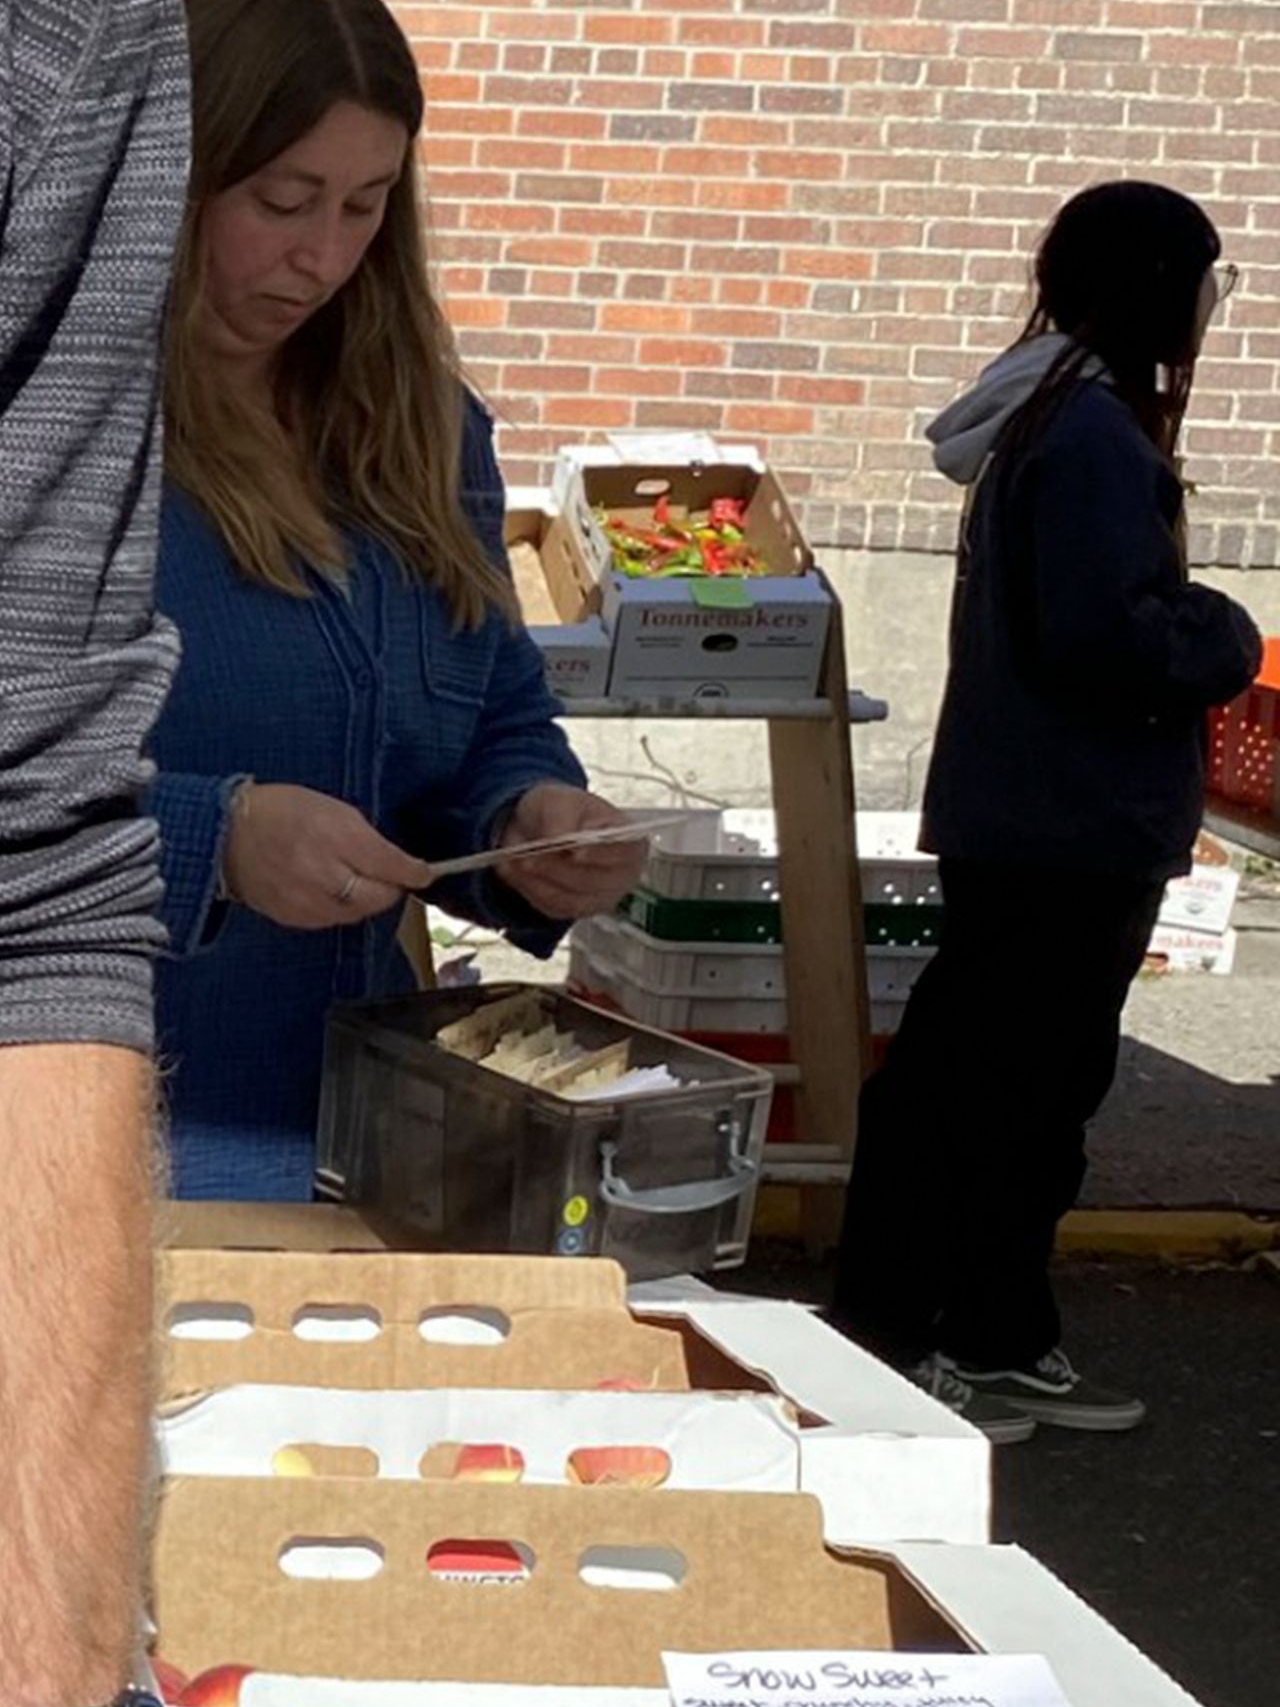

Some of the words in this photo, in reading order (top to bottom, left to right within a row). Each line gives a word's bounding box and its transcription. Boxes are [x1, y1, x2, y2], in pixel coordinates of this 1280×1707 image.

[638, 607, 809, 628] Tonnemakers
[707, 1661, 817, 1691] Snow
[820, 1661, 949, 1690] Sweet
